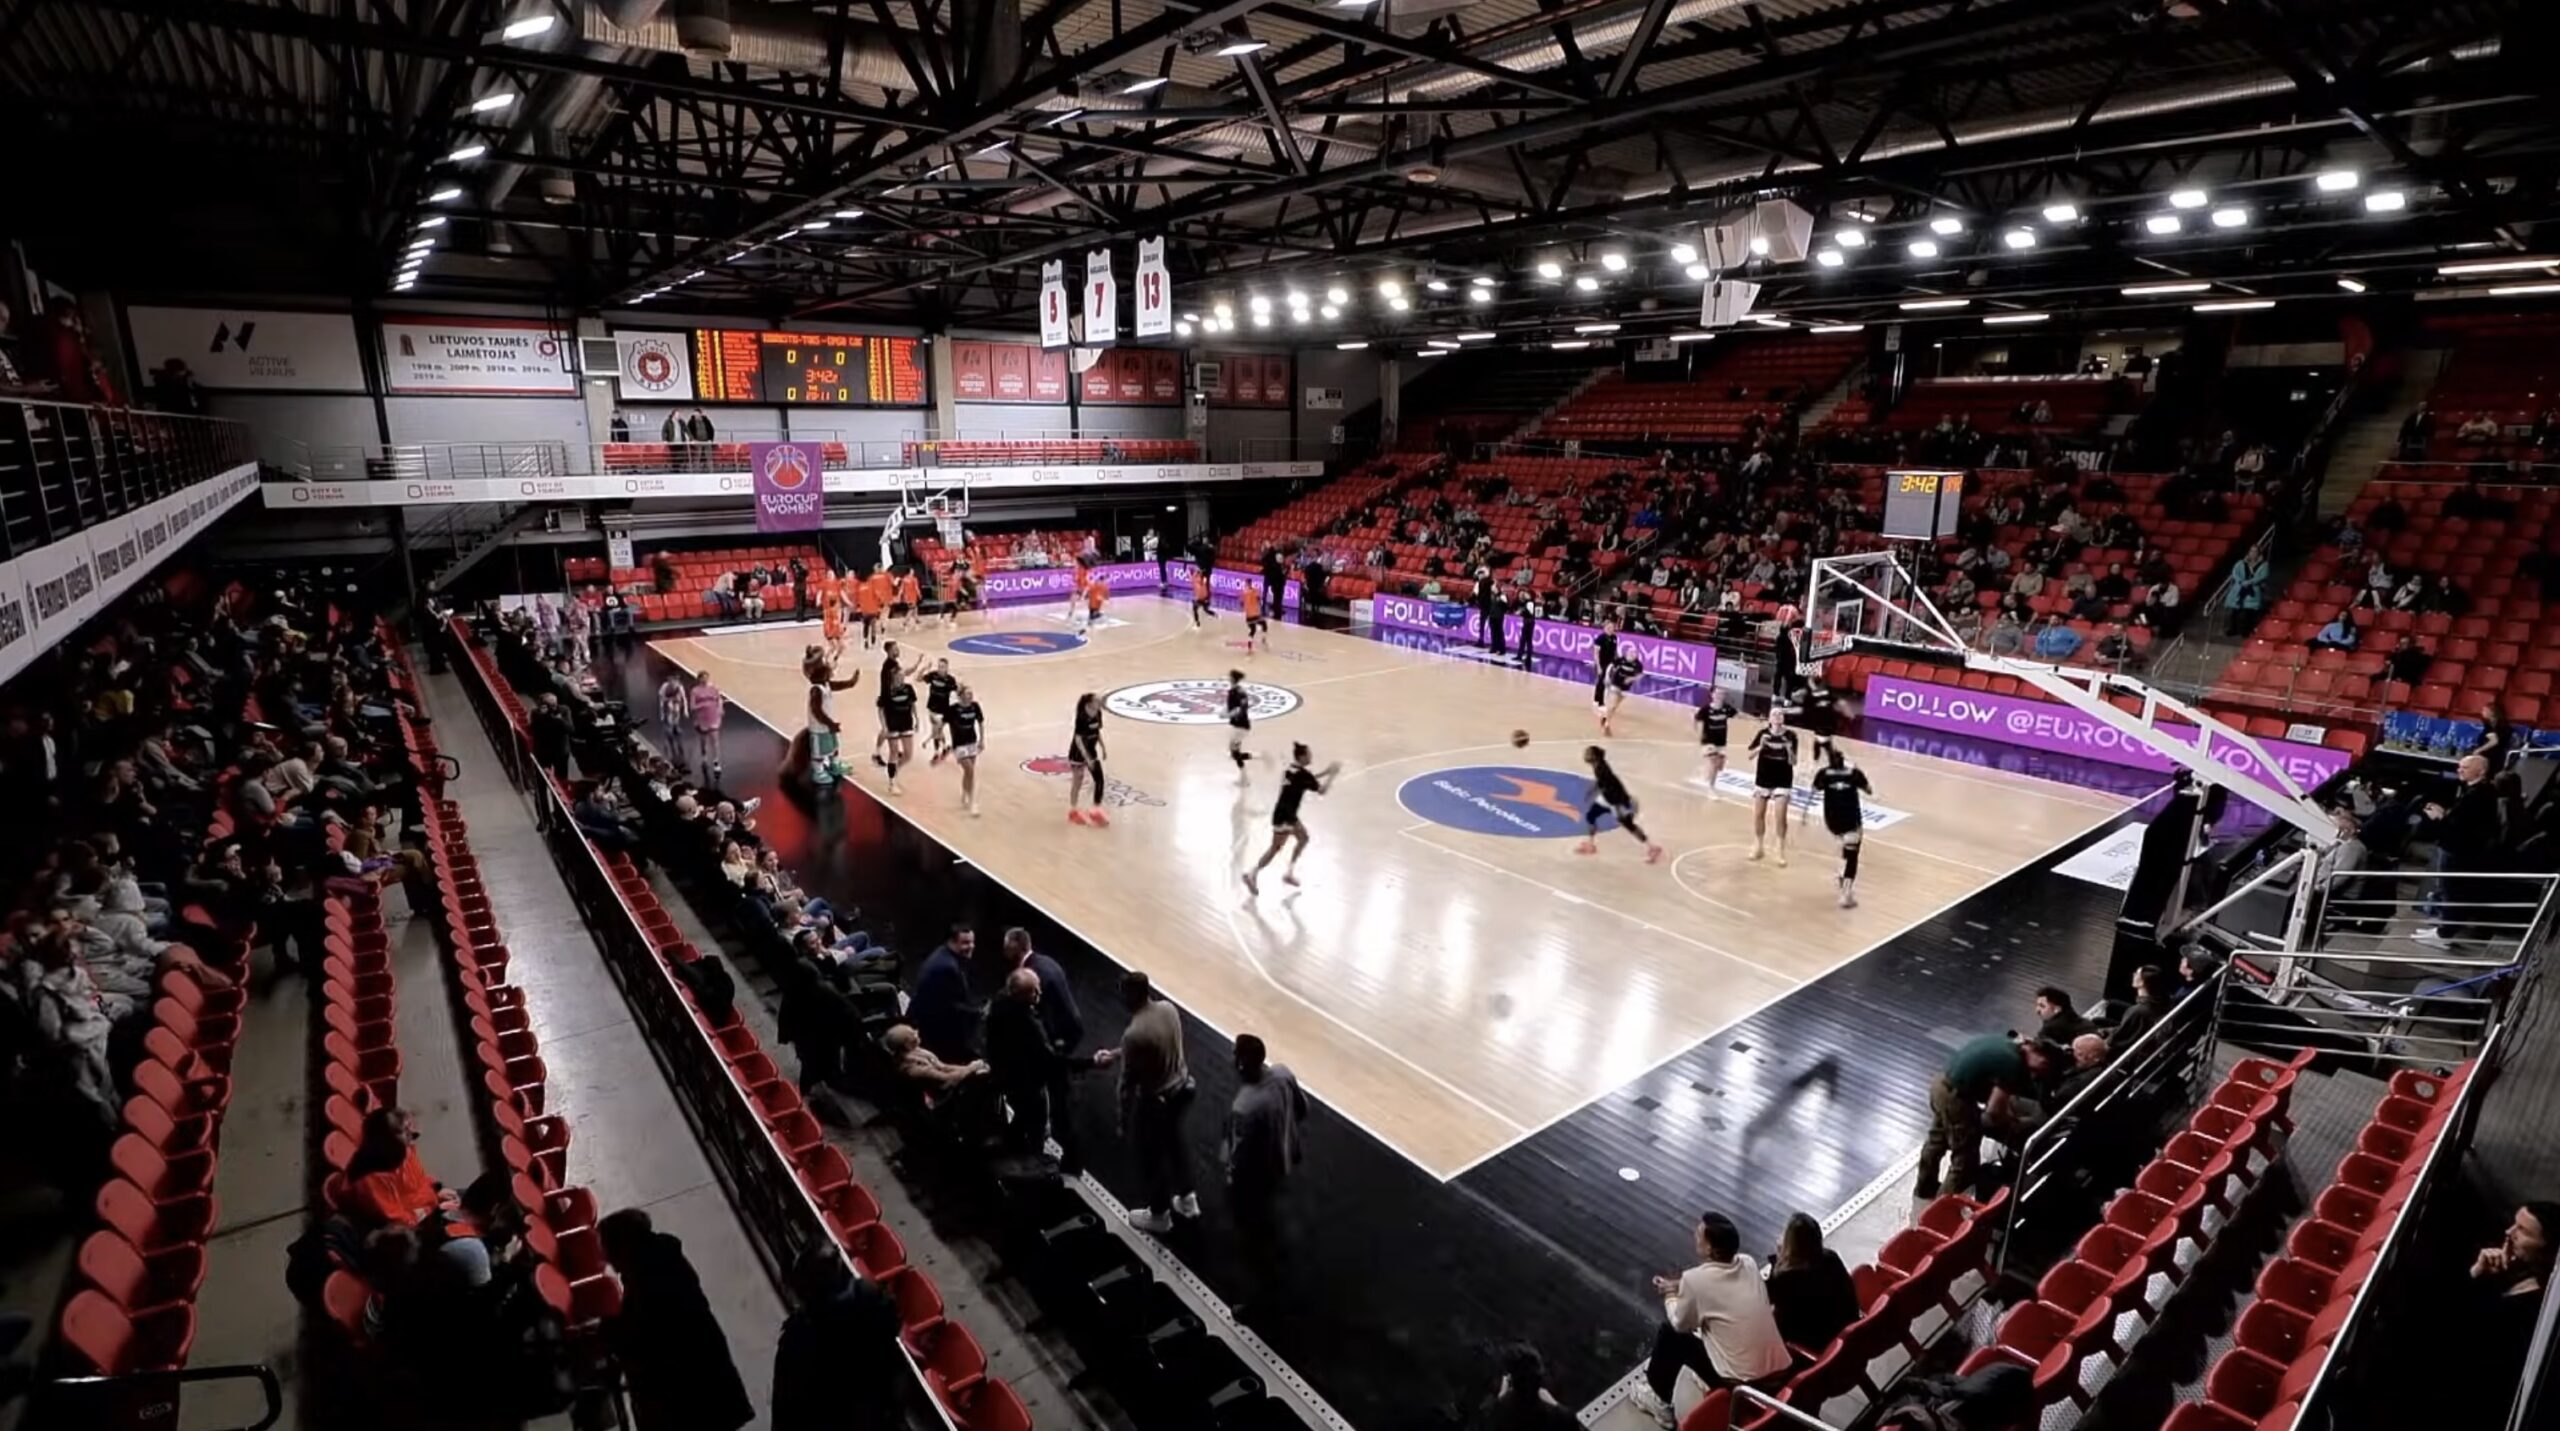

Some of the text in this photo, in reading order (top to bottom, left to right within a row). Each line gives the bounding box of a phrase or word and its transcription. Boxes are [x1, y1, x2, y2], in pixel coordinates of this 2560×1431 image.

[1094, 281, 1105, 318] 7
[1143, 271, 1161, 311] 13
[1049, 290, 1058, 324] 5
[428, 335, 485, 347] LIETUVOS
[787, 349, 797, 364] 0
[835, 351, 845, 365] 0
[787, 387, 797, 401] 0
[838, 388, 848, 401] 0
[1900, 475, 1938, 493] 3:42
[761, 493, 818, 505] EUROCUP
[765, 502, 814, 514] WOMEN
[985, 576, 1044, 592] FOLLOW
[1881, 688, 1997, 724] FOLLOW
[1432, 779, 1542, 833] Baltic Petroleum
